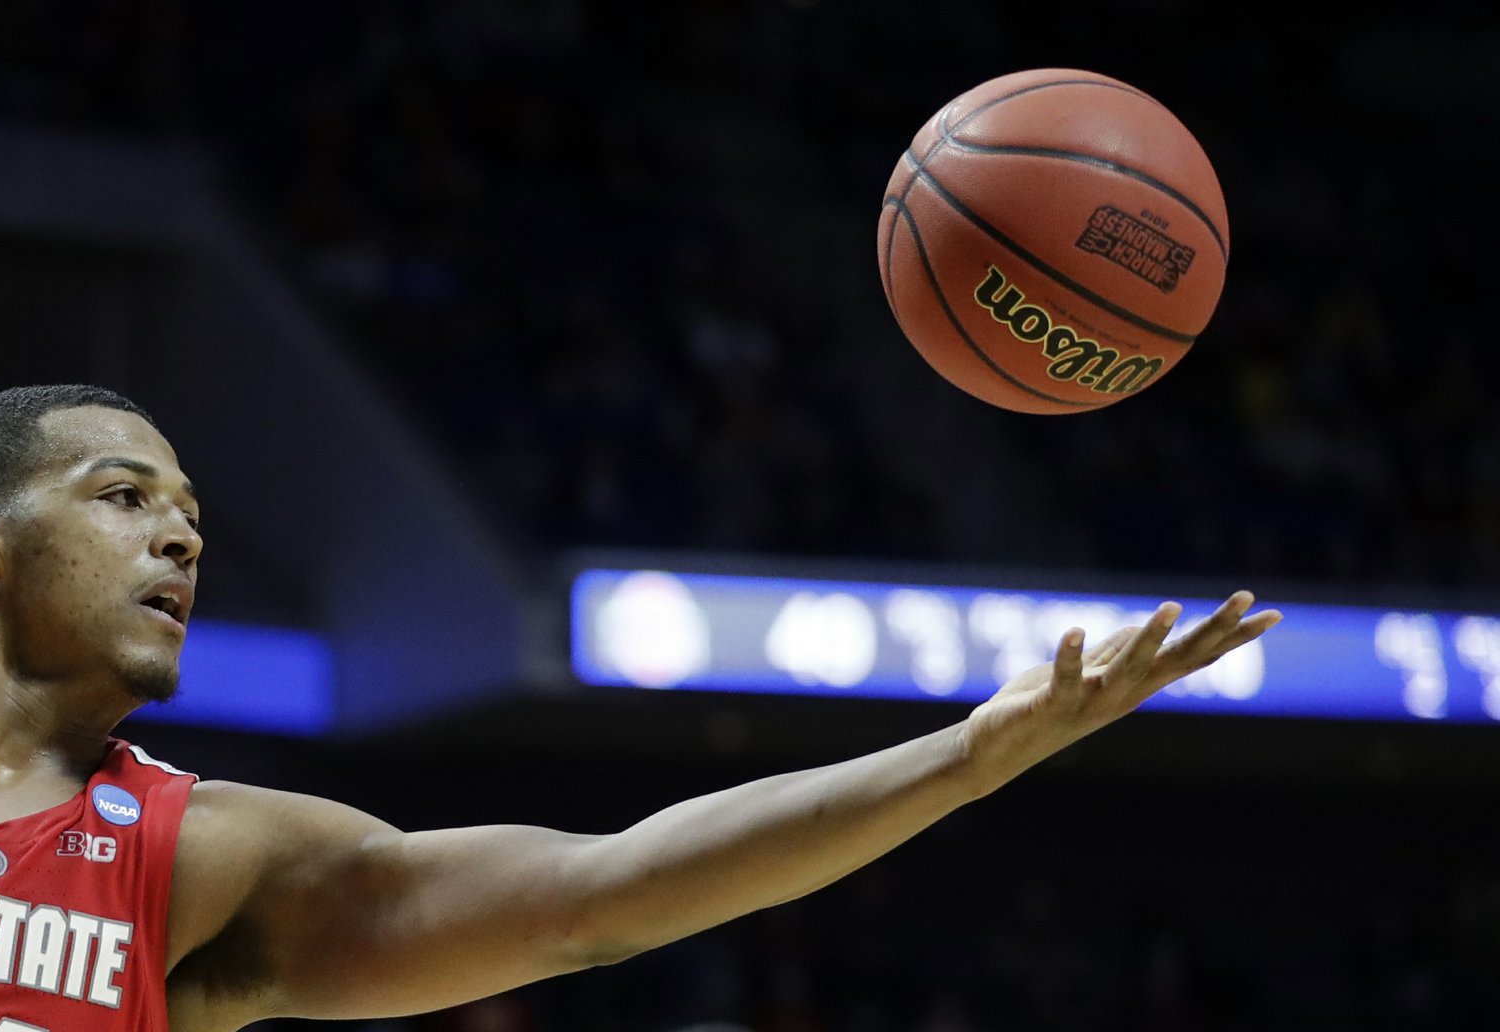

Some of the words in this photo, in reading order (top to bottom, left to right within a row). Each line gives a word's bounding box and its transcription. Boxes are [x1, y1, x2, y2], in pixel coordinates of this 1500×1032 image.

[1091, 209, 1171, 262] MADNESS
[1108, 241, 1168, 284] MARCH
[974, 264, 1164, 393] Wilson
[98, 799, 139, 819] NCAA
